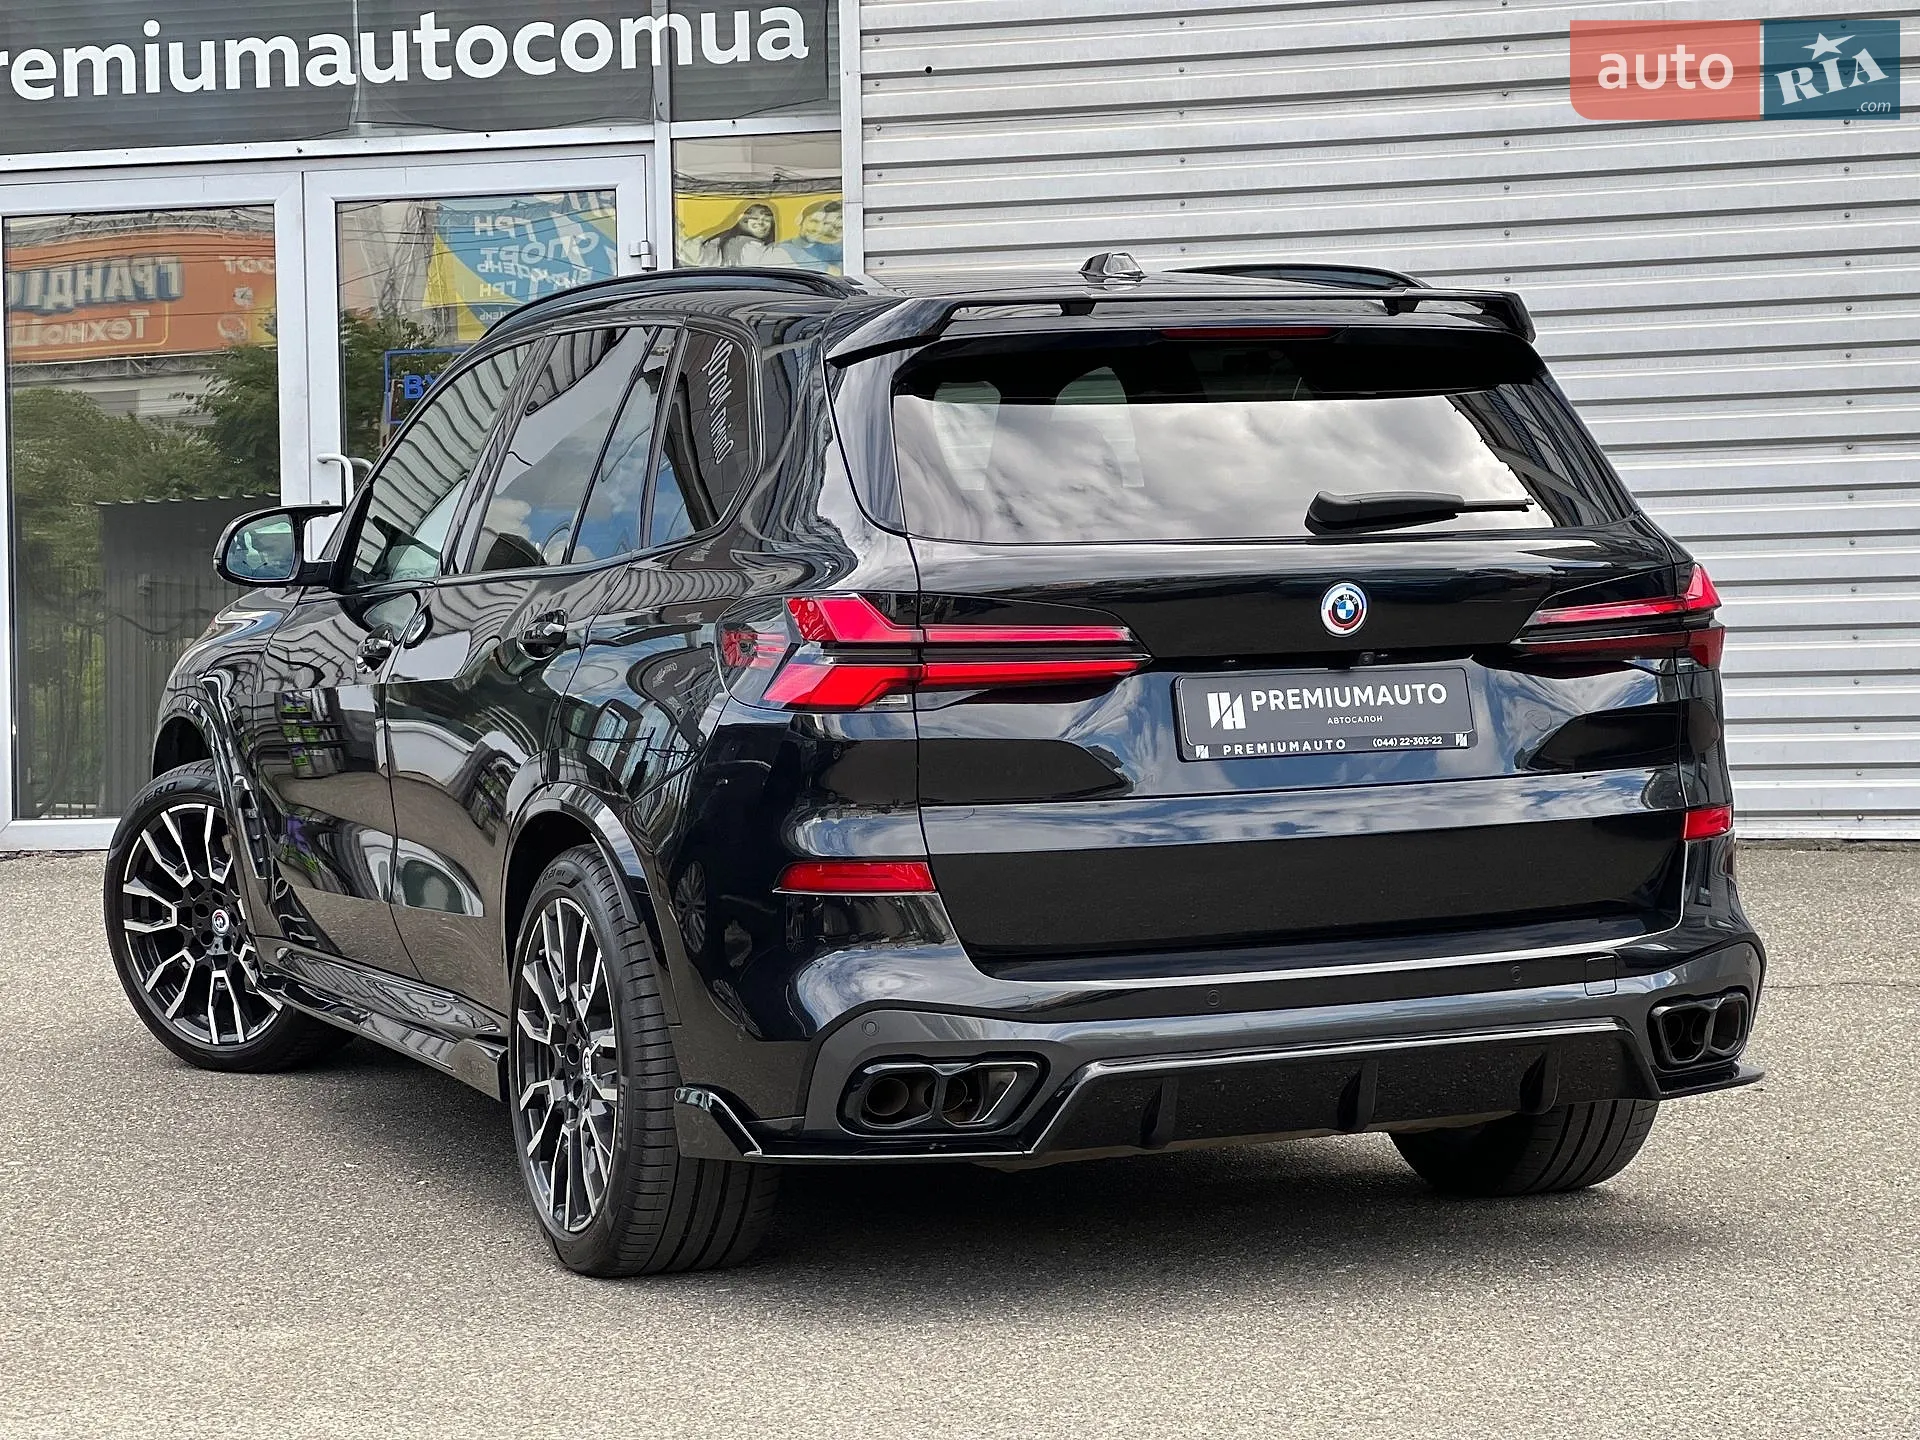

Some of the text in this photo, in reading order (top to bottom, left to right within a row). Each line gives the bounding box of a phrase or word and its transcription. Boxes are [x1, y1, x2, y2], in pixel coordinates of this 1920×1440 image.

[1251, 682, 1447, 712] PREMIUMAUTO
[1327, 715, 1383, 725] АВТОСАЛОН
[1223, 735, 1443, 756] PREMIUMAUTO (044) 22-303-22
